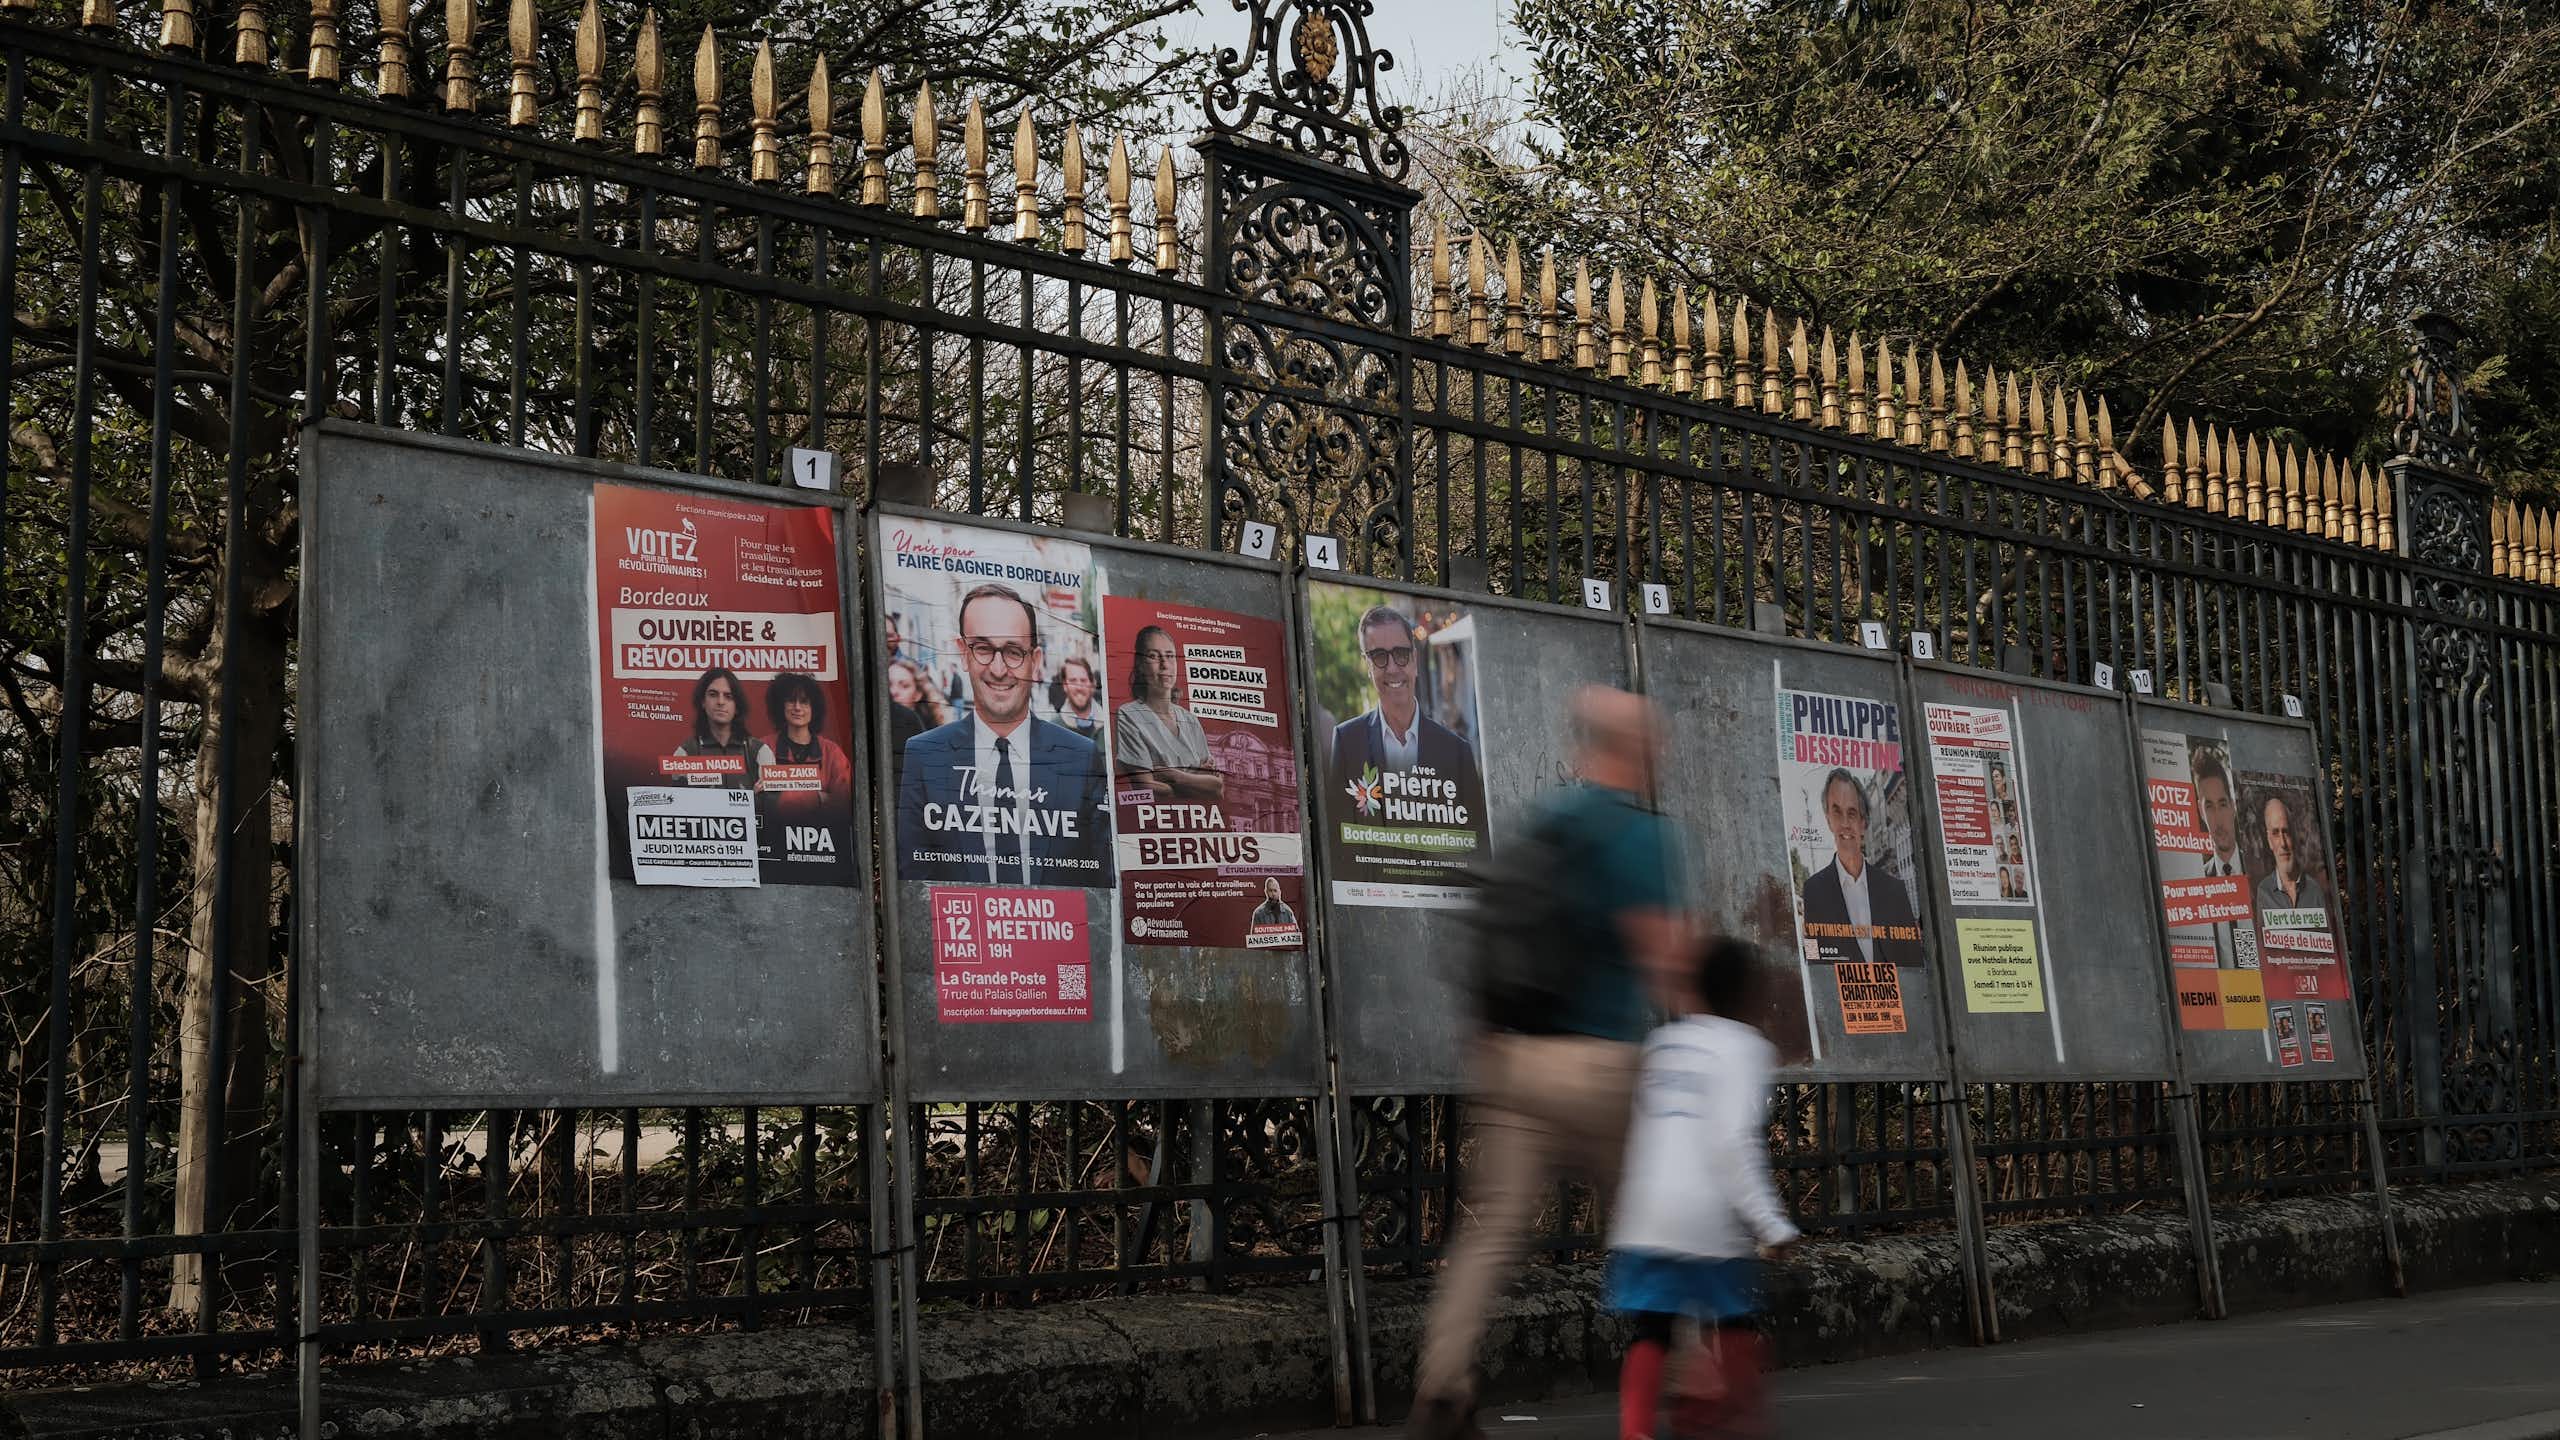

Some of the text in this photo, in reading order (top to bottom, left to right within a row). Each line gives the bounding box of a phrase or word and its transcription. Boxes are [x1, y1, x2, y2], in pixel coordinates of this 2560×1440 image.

[807, 457, 817, 480] 1
[675, 504, 765, 523] Élections municipales 2026
[625, 527, 698, 562] VOTEZ
[740, 538, 795, 554] Pour que les
[892, 529, 975, 564] Unis pour
[1251, 529, 1263, 549] 3
[640, 555, 669, 564] POUR DES
[740, 551, 790, 565] travailleurs
[1317, 545, 1328, 564] 4
[619, 559, 702, 577] RÉVOLUTIONNAIRES
[741, 562, 823, 577] et les travailleuses
[897, 553, 1080, 588] FAIRE GAGNER BORDEAUX
[742, 573, 823, 588] décident de tout
[620, 587, 708, 607] Bordeaux
[1593, 587, 1601, 603] 5
[1652, 591, 1661, 609] 6
[638, 615, 776, 641] OUVRIÈRE &
[1183, 616, 1241, 629] municipales Bordeaux
[1870, 630, 1878, 645] 7
[1187, 648, 1242, 660] ARRACHER
[1918, 640, 1926, 655] 8
[627, 643, 819, 670] RÉVOLUTIONNAIRE
[1189, 666, 1264, 685] BORDEAUX
[2101, 671, 2107, 685] 9
[2135, 673, 2148, 688] 10
[1192, 689, 1261, 704] AUX RICHES
[628, 702, 650, 710] SELMA
[1927, 707, 1952, 720] LUTTE
[2286, 699, 2298, 713] 11
[650, 713, 683, 721] QUIRANTE
[1202, 708, 1217, 717] AUX
[1219, 708, 1275, 724] SPÉCULATEURS
[1792, 694, 1899, 742] PHILIPPE
[1979, 714, 2000, 725] CAMP DES
[1974, 723, 2003, 735] TRAVAILLEURS
[1970, 749, 2000, 761] PUBLIQUE
[663, 759, 742, 771] Esteban NADAL
[764, 767, 818, 778] Nora ZAKRI
[1412, 765, 1435, 776] Avec
[953, 766, 1048, 803] Thomas
[1383, 772, 1457, 799] Pierre
[729, 792, 749, 802] NPA
[1121, 793, 1151, 802] VOTEZ
[2148, 785, 2192, 805] VOTEZ
[1137, 804, 1225, 830] PETRA
[1385, 797, 1468, 824] Hurmic
[2152, 809, 2190, 827] MEDHI
[638, 816, 744, 839] MEETING
[923, 802, 1079, 838] CAZENAVE
[785, 826, 835, 852] NPA
[1343, 826, 1476, 847] Bordeaux en confiance
[2155, 830, 2214, 850] Saboulard
[642, 844, 743, 855] JEUDI 12 MARS à 19H
[1138, 836, 1260, 865] BERNUS
[1946, 847, 1968, 855] Samedi
[913, 850, 1099, 869] ÉLECTIONS MUNICIPALES & 22 MARS 2026
[1355, 855, 1416, 866] ÉLECTIONS MUNICIPALES
[1135, 881, 1151, 889] Pour
[1154, 882, 1176, 892] porter
[1178, 881, 1184, 889] la
[1186, 881, 1200, 889] voix
[1202, 881, 1214, 889] des
[1952, 889, 1979, 897] Bordeaux
[2164, 880, 2237, 899] Pour une gauche
[1136, 891, 1145, 899] de
[1154, 891, 1186, 901] jeunesse
[1198, 890, 1210, 898] des
[1211, 889, 1243, 900] quartiers
[943, 900, 972, 915] JEU
[984, 898, 1055, 918] GRAND
[1136, 900, 1174, 909] populaires
[2167, 902, 2249, 922] Ni PS Ni Extrême
[1147, 918, 1183, 928] Révolution
[2265, 911, 2325, 928] Vert de rage
[946, 917, 972, 940] 12
[986, 920, 1073, 941] MEETING
[1147, 927, 1188, 938] Permanente
[1890, 927, 1917, 941] FORCE
[1248, 935, 1279, 945] ANASSE
[2264, 929, 2333, 949] Rouge de lutte
[944, 943, 976, 958] MAR
[988, 944, 1012, 958] 19H
[1973, 944, 2023, 953] Réunion publique
[941, 971, 1046, 985] La Grande Poste
[1837, 964, 1895, 984] HALLE DES
[942, 989, 1047, 1000] 7 rue du Palais Gallien
[1841, 984, 1899, 1001] CHARTRONS
[2181, 991, 2217, 1006] MEDHI
[944, 1007, 1087, 1018] Inscription fairegagnerbordeaux.fr/mt
